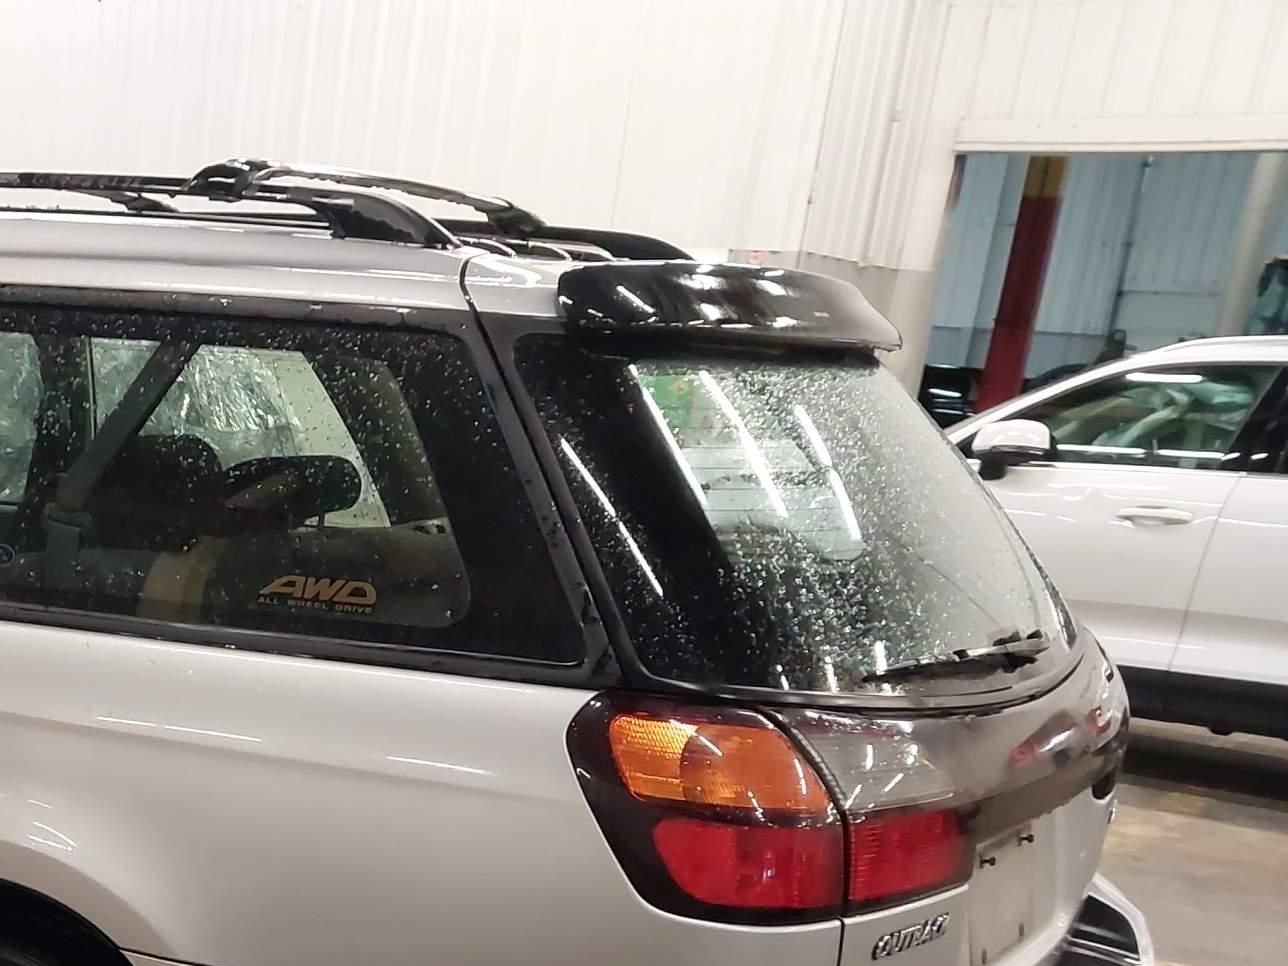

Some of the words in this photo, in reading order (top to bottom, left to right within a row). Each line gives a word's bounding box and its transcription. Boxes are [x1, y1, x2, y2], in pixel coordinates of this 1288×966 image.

[259, 574, 377, 606] AWD
[256, 596, 280, 606] ALL
[287, 599, 329, 611] WHEEL
[334, 604, 373, 615] DRIVE
